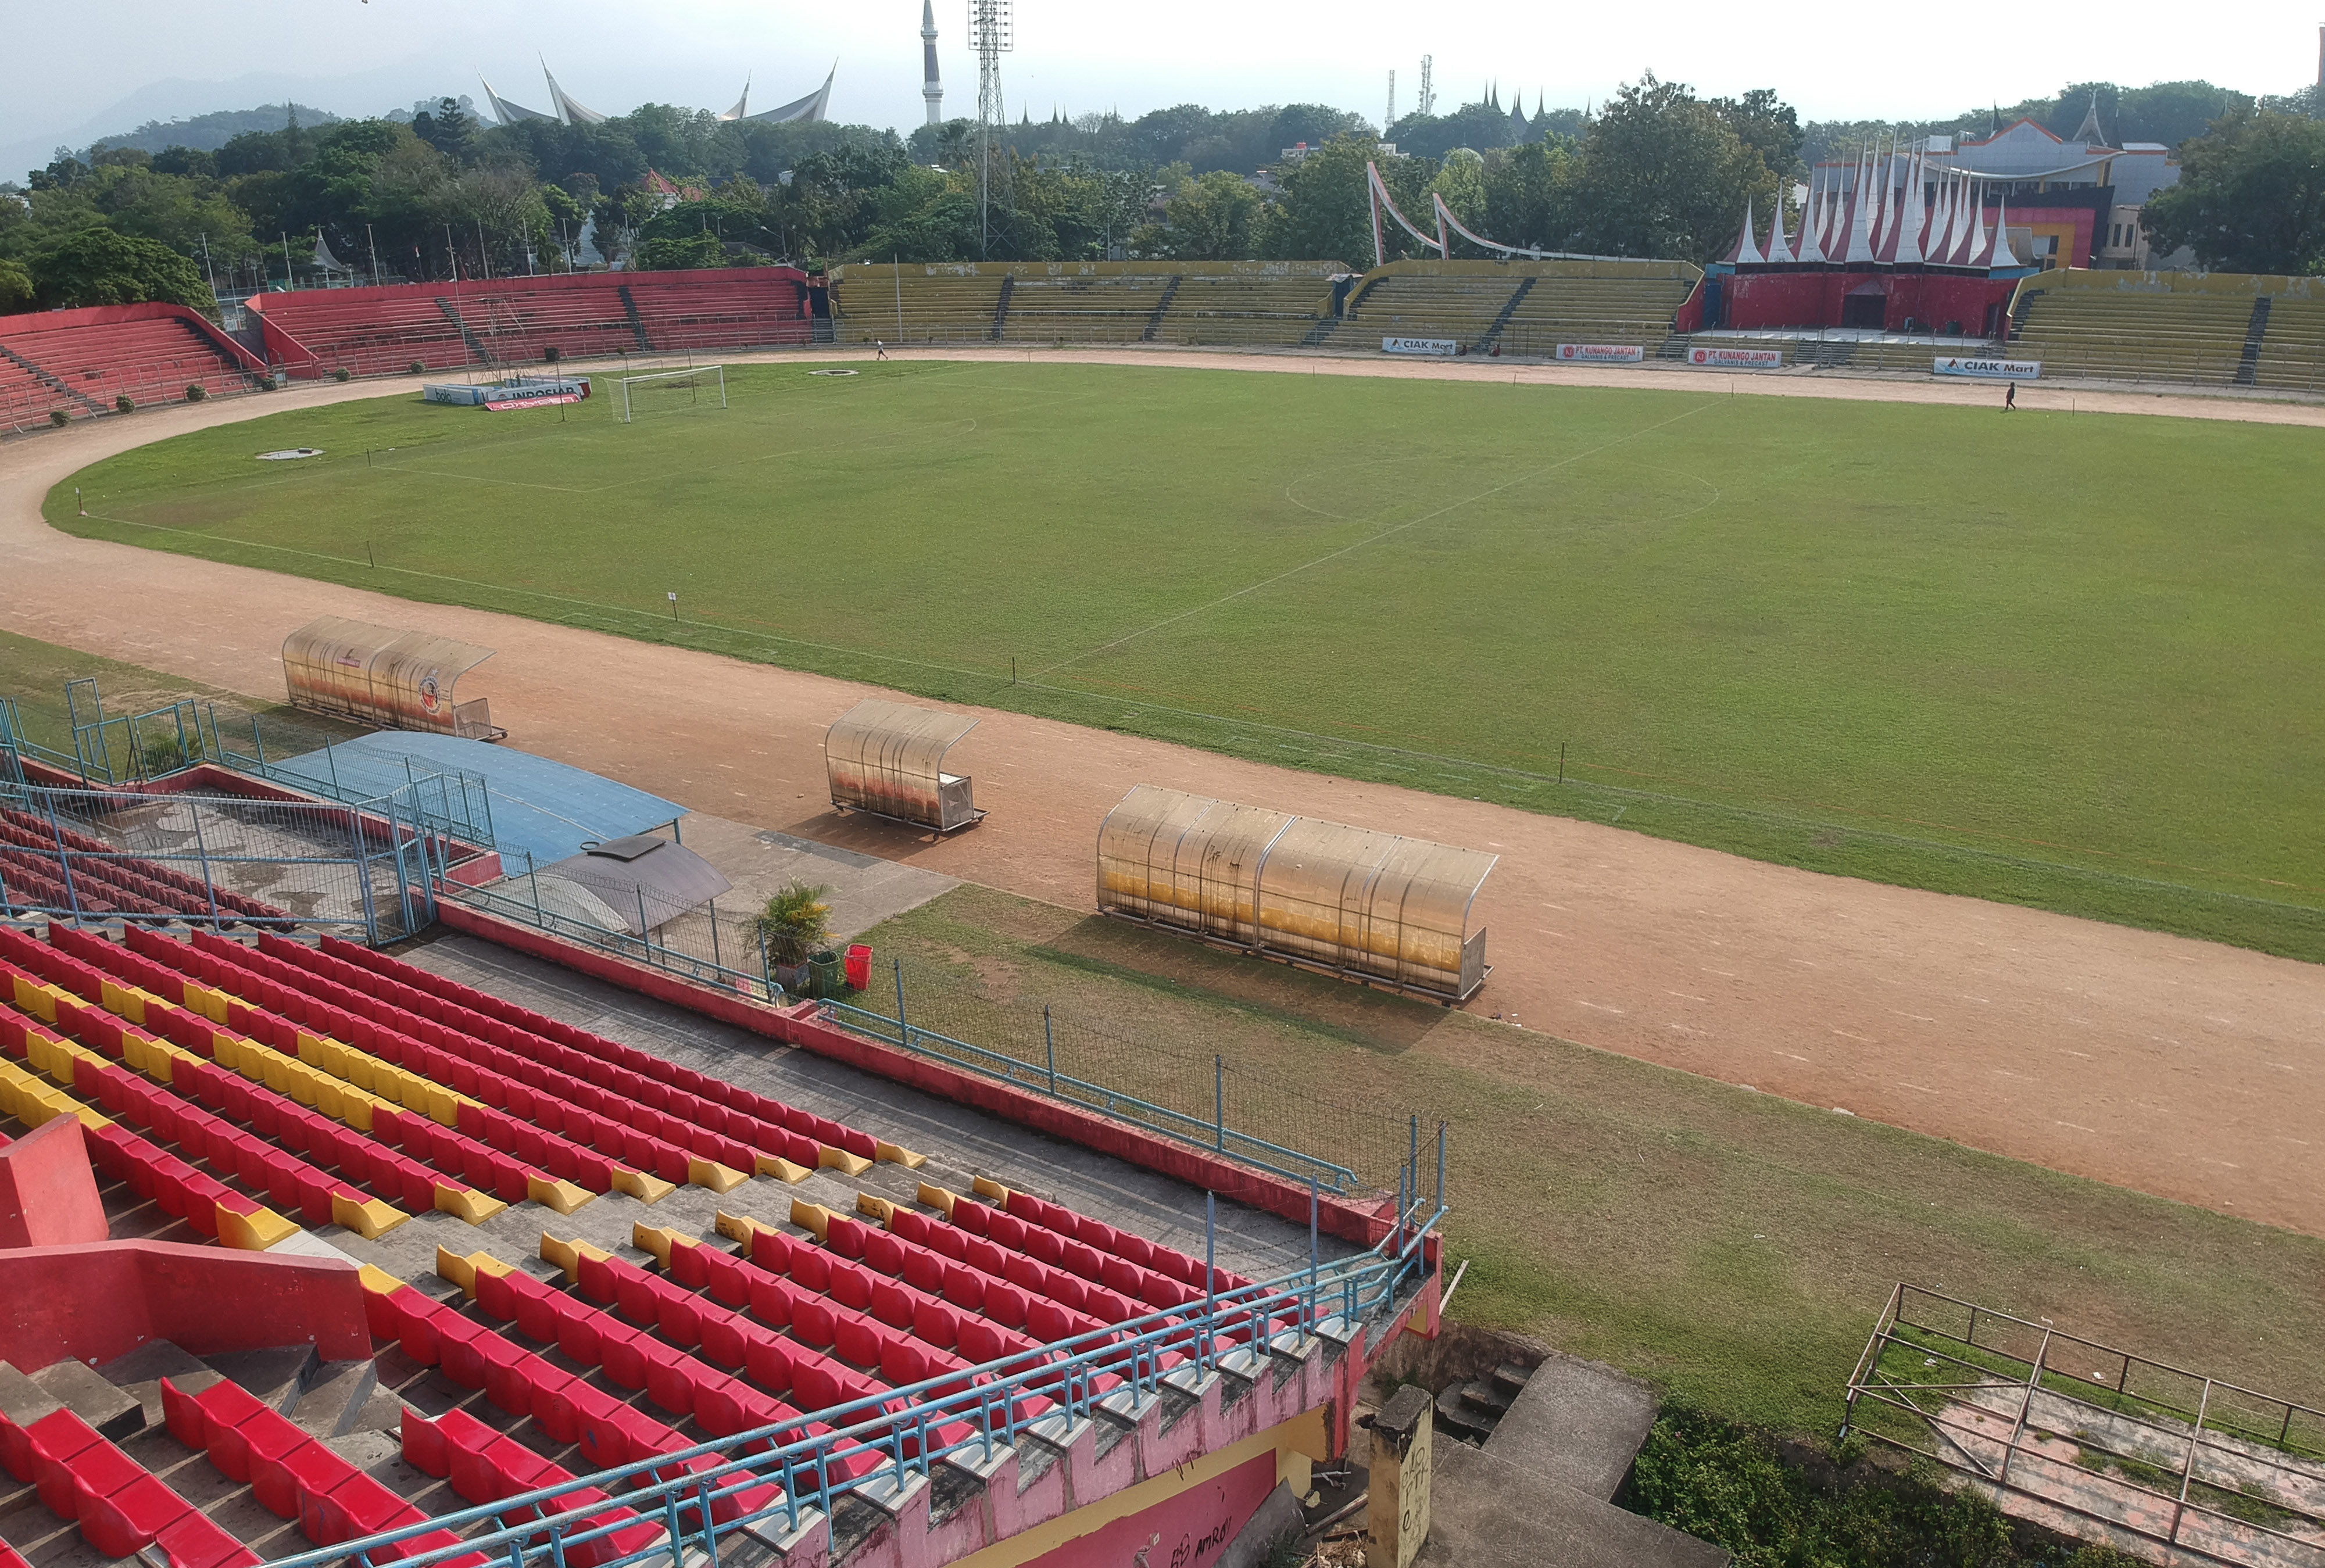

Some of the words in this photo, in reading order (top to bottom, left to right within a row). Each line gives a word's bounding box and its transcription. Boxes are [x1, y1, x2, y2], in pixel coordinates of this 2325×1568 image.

[1404, 341, 1429, 349] CIAK
[1586, 346, 1612, 355] KUNANGO
[1614, 347, 1636, 356] JANTAN
[1719, 351, 1750, 361] KUNANGO
[1751, 352, 1776, 361] JANTAN
[1964, 361, 2000, 371] CIAK
[2004, 364, 2034, 373] Mart
